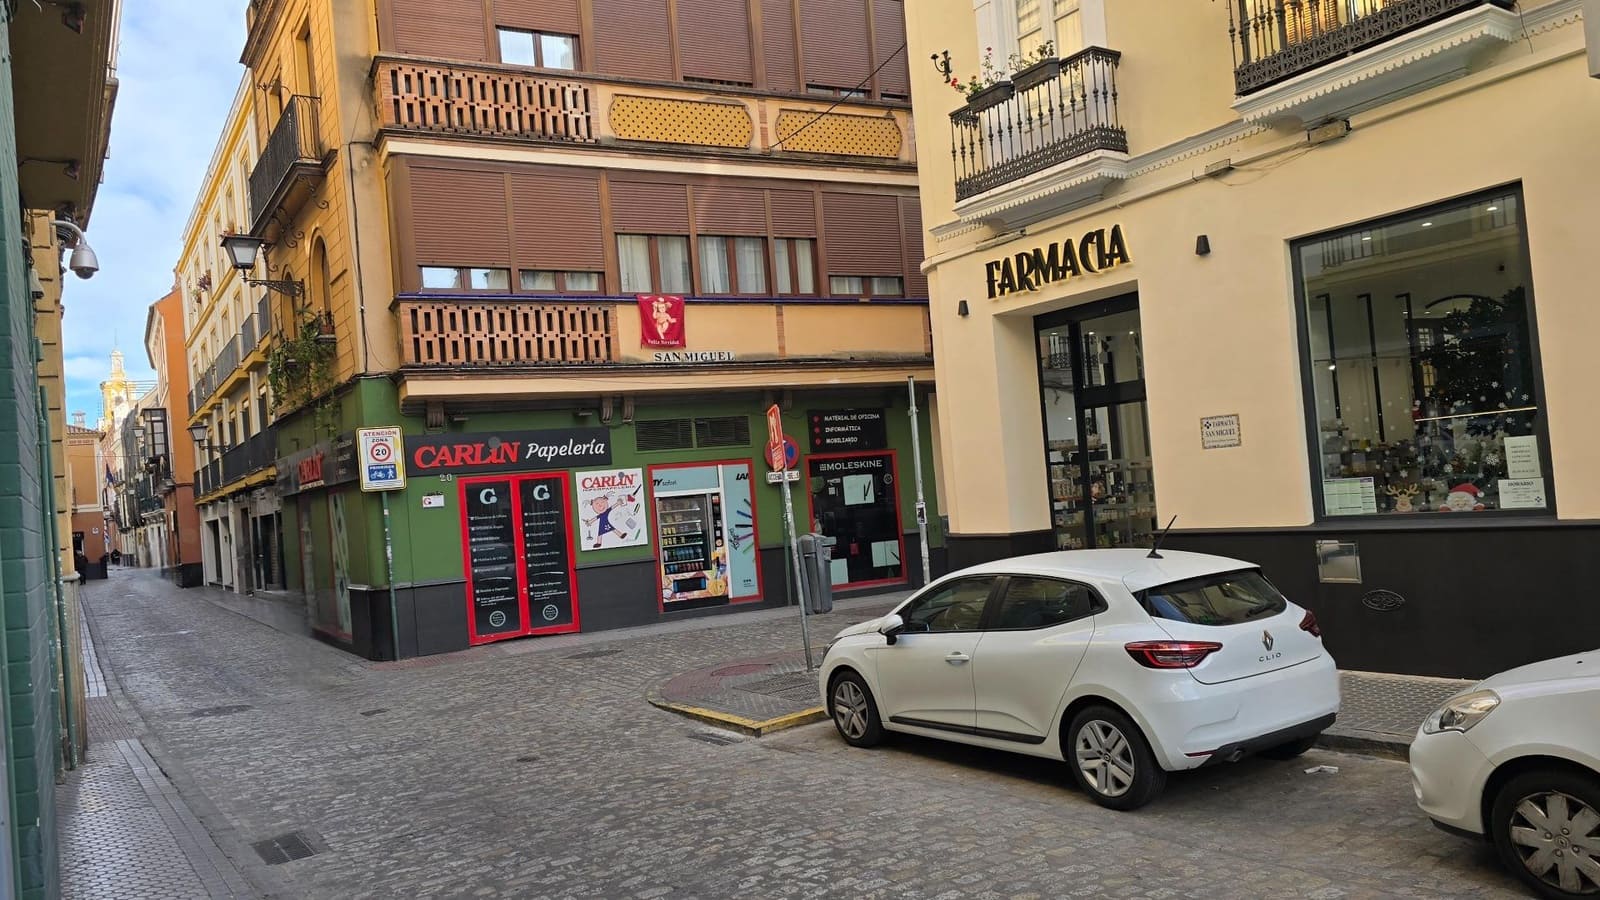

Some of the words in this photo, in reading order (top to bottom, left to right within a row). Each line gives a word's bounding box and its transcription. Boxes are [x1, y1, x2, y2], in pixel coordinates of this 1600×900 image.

[985, 224, 1130, 299] FARMACIA
[654, 352, 680, 362] SAN
[685, 351, 735, 362] MIGUEL
[825, 425, 861, 433] INFORMÁTICA
[375, 448, 388, 456] 20
[526, 438, 605, 462] Papelería
[827, 460, 883, 471] MOLESKINE
[439, 473, 452, 482] 20
[1259, 652, 1281, 662] CLIO
